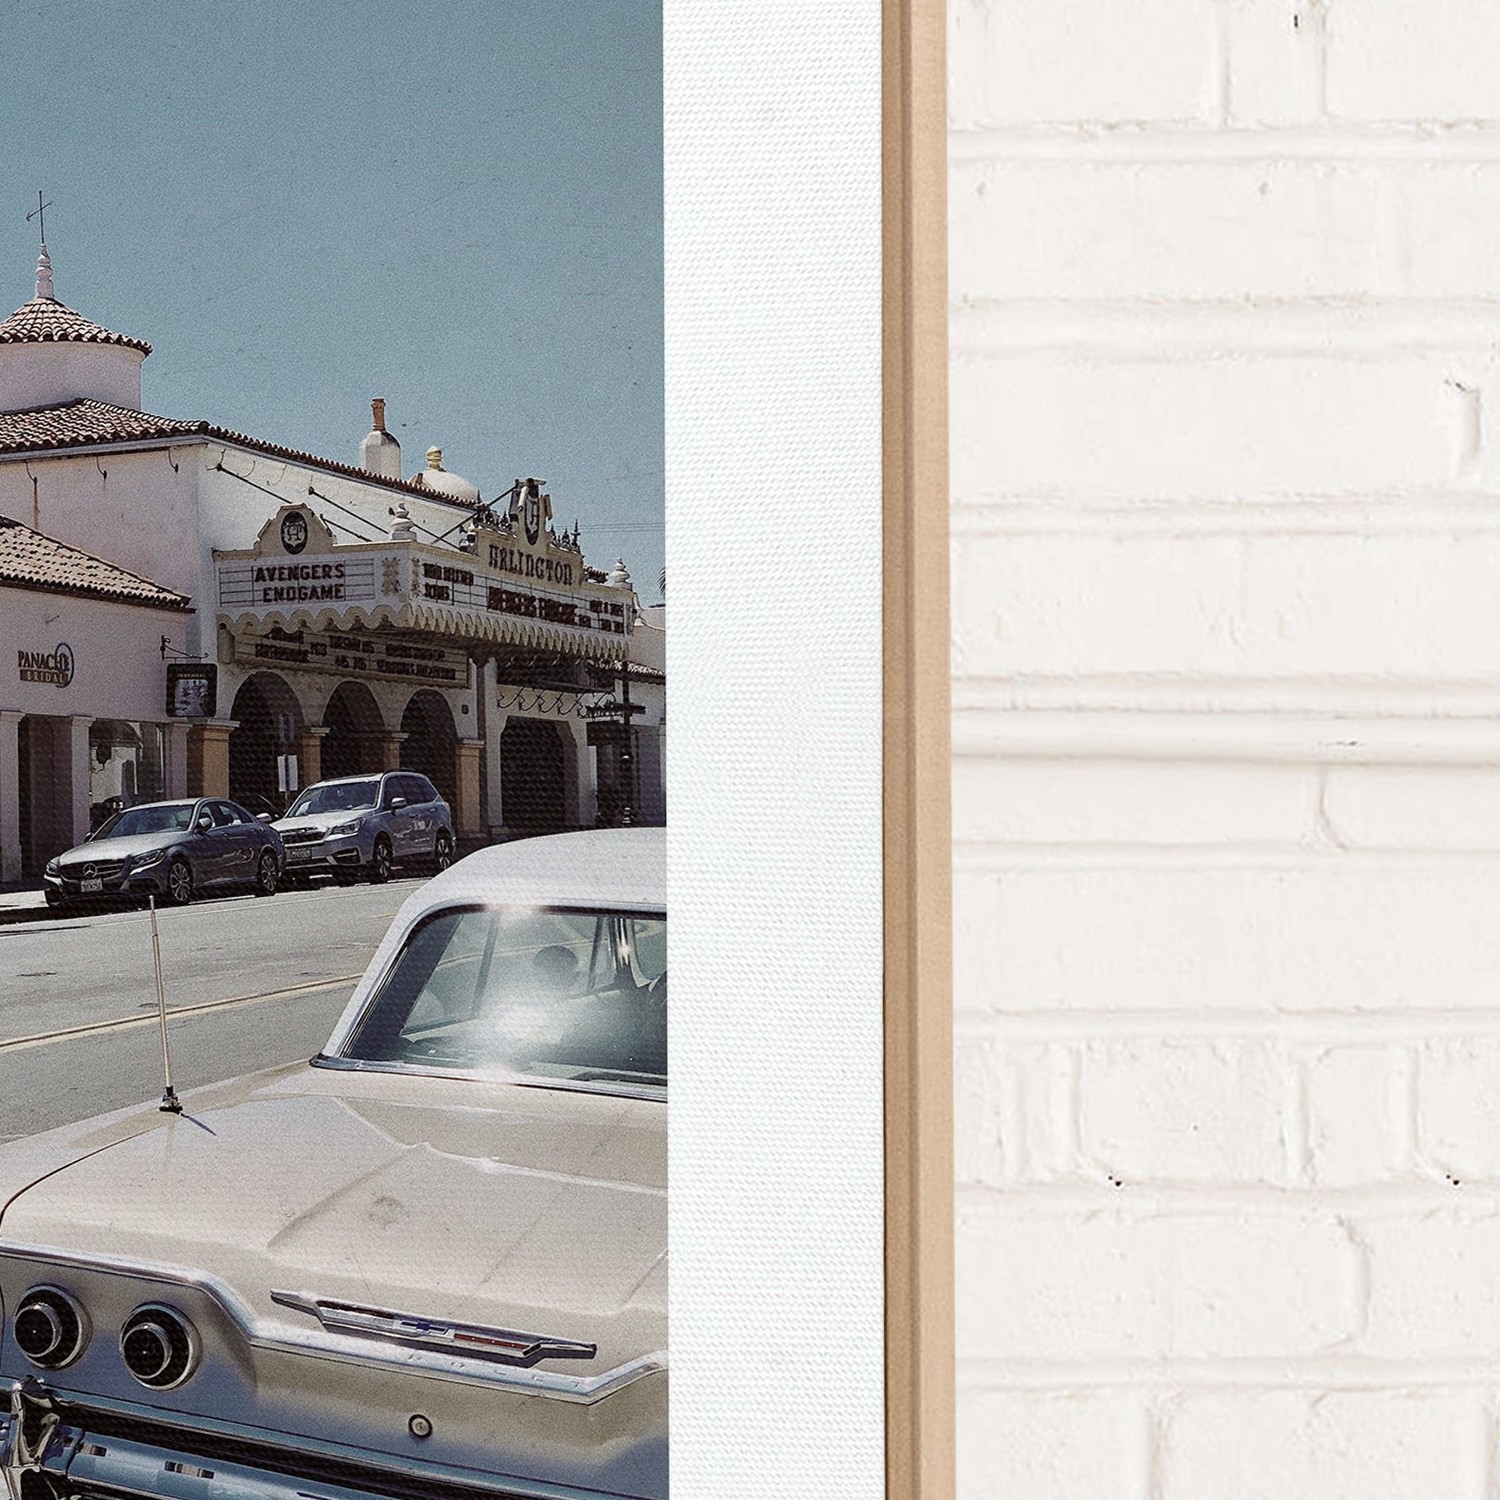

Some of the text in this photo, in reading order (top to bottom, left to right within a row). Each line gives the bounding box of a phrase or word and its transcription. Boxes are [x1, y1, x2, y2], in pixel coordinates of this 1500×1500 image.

[254, 563, 345, 583] AVENGERS
[488, 544, 573, 586] ARLINGTON
[263, 583, 345, 603] ENDGAME
[17, 650, 70, 673] PANACHE
[26, 670, 64, 683] BRIDAL
